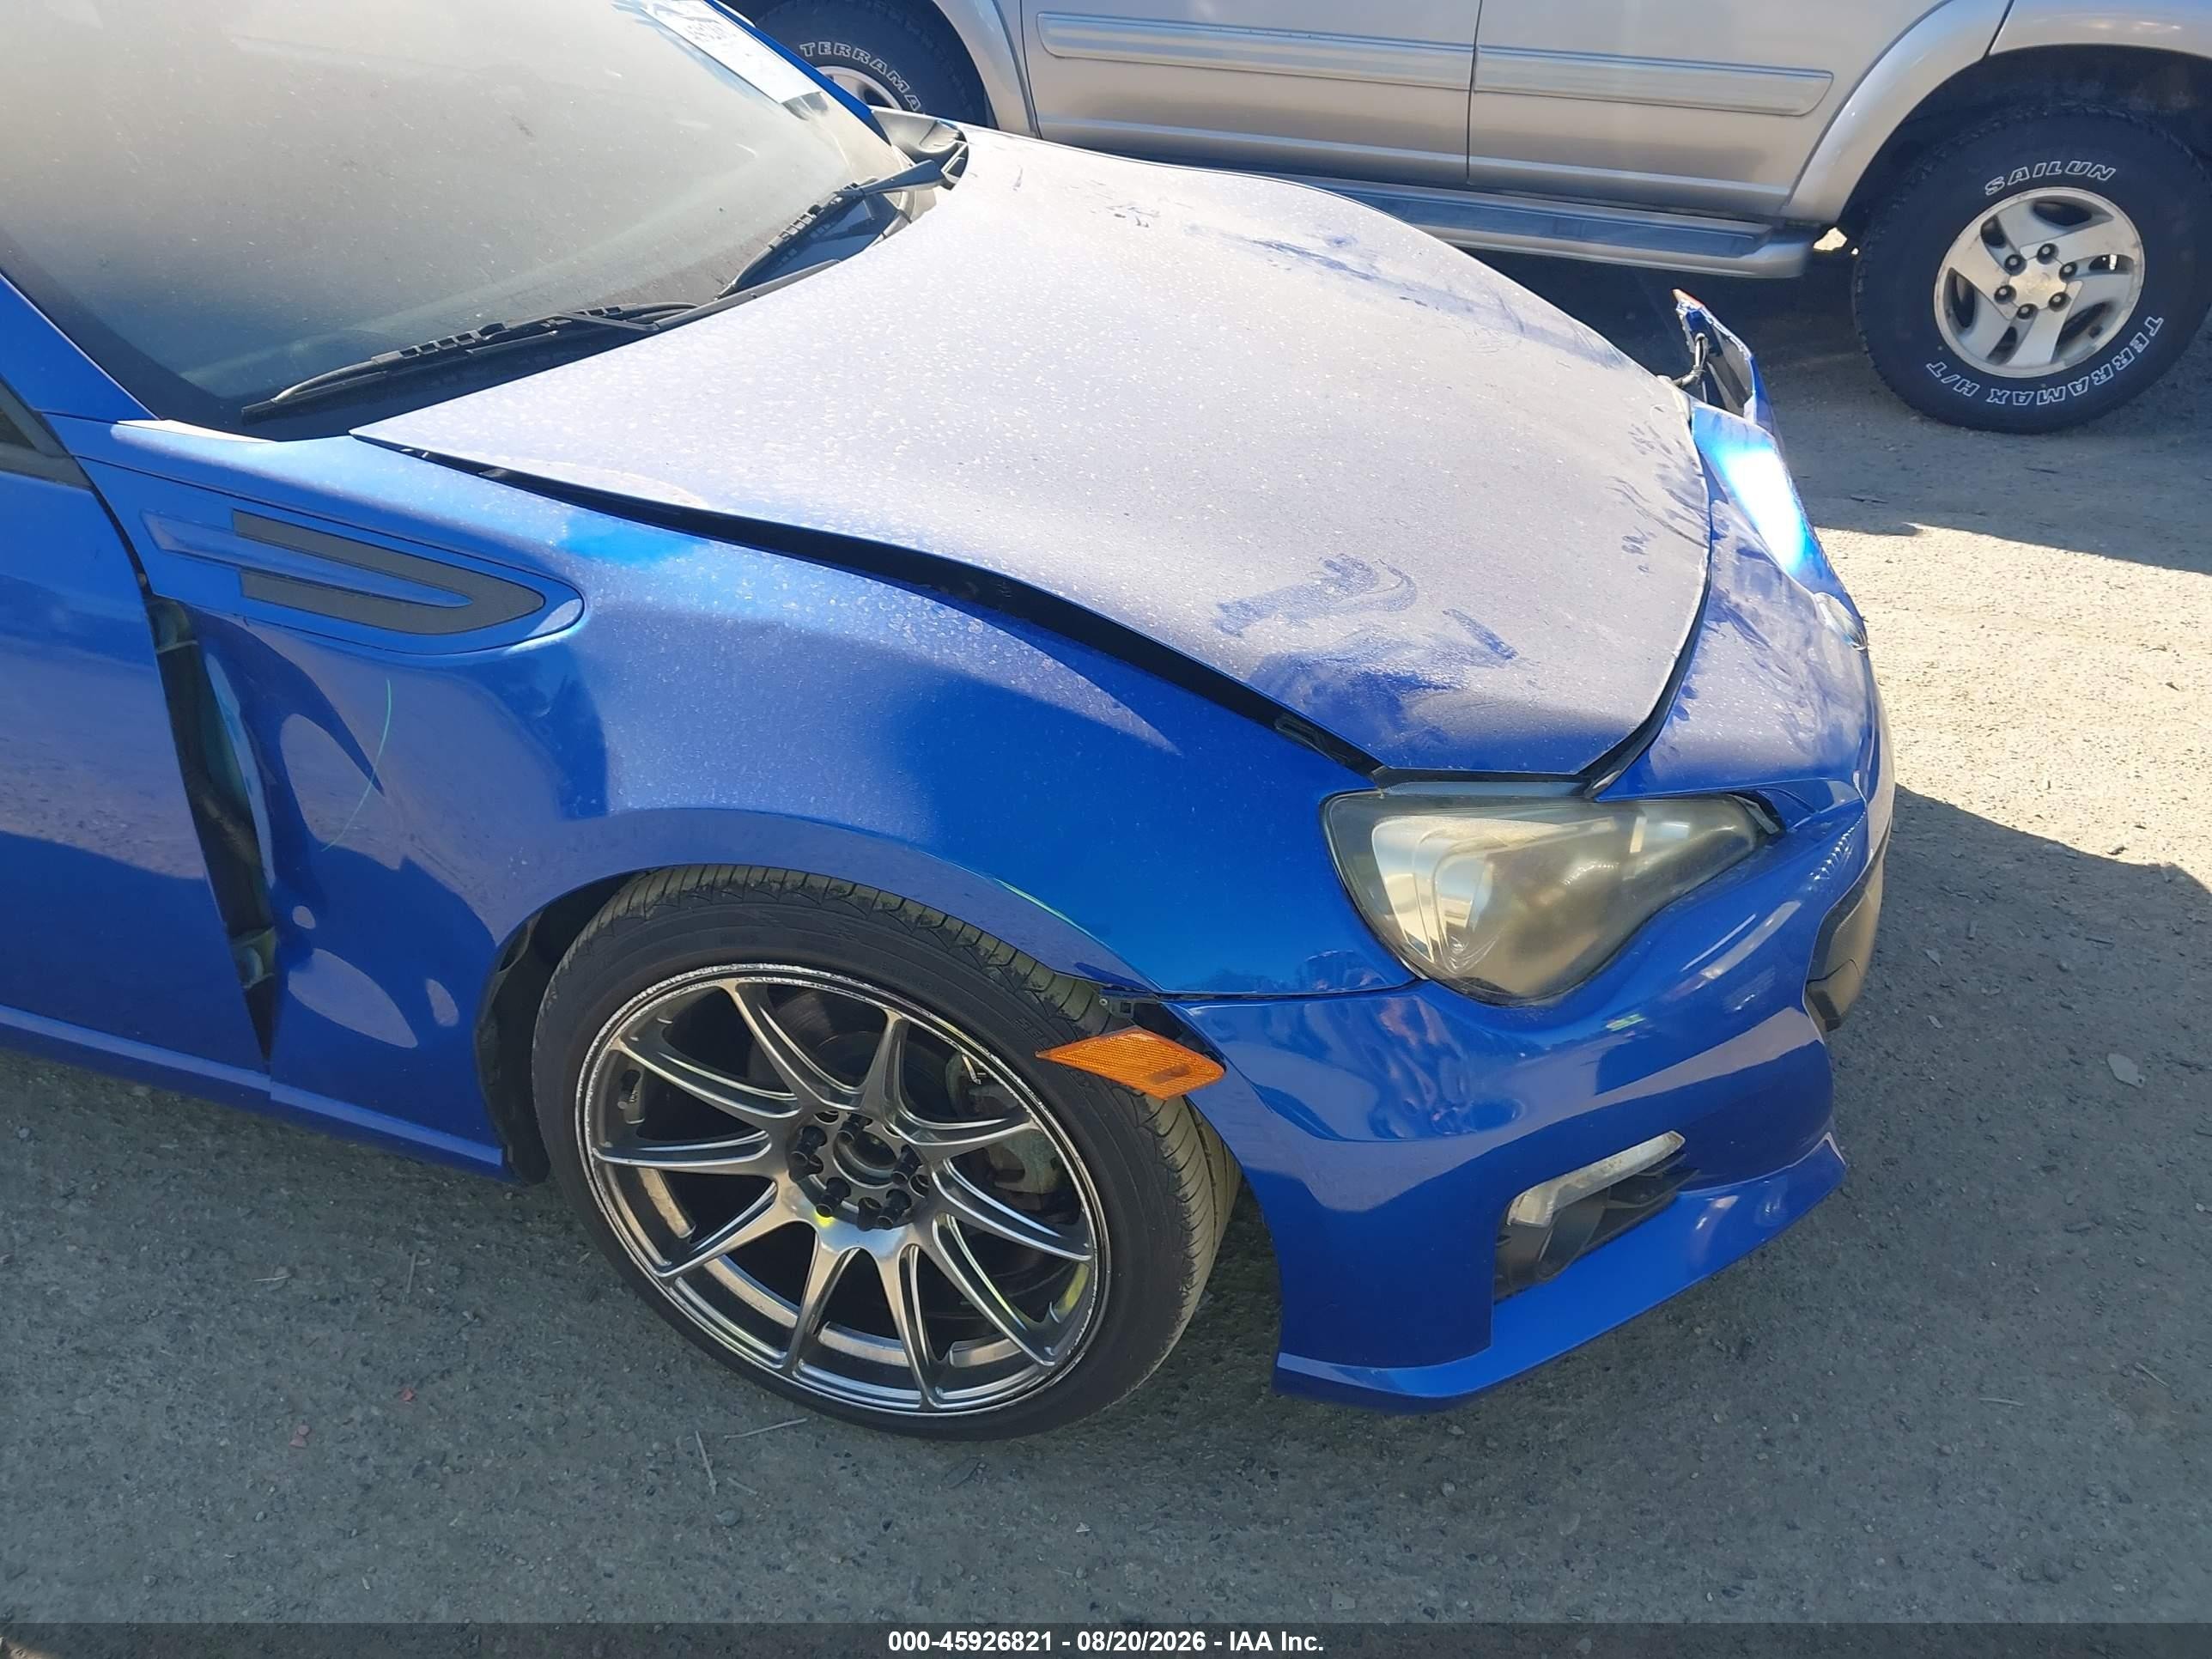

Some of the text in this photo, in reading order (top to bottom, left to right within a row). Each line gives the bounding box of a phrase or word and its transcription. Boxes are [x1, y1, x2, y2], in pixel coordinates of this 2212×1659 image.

[799, 41, 925, 112] TERRAMA
[1984, 161, 2116, 196] SAILUN
[1925, 315, 2164, 406] TERRAMAX H/T
